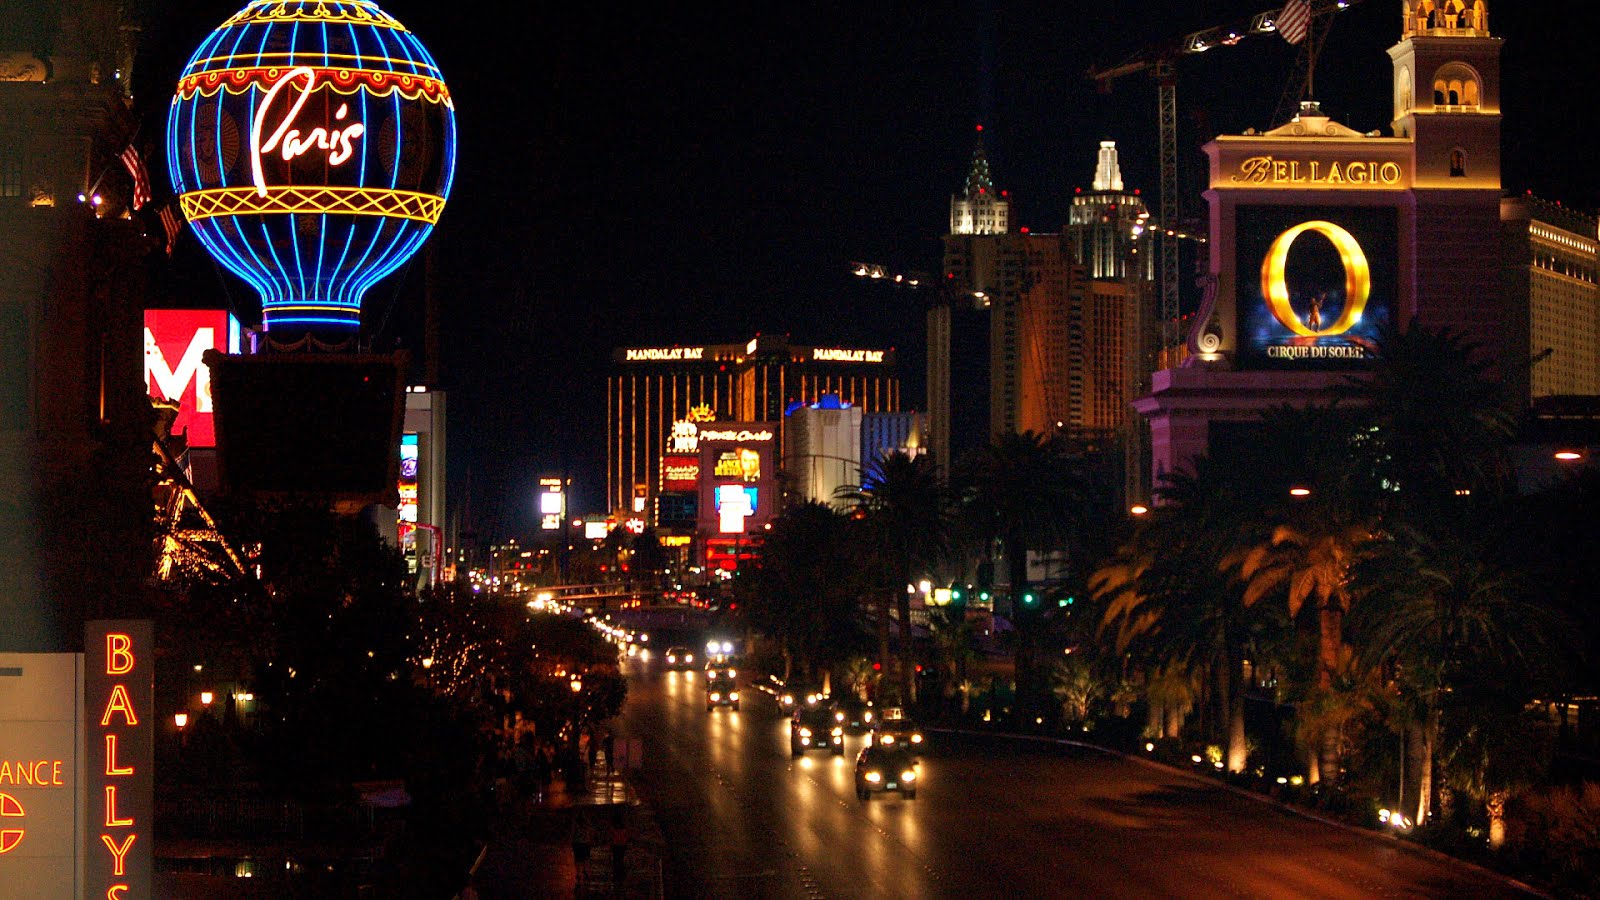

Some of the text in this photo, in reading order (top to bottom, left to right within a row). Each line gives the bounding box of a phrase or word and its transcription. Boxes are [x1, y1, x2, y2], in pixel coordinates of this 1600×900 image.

[251, 66, 364, 198] Paris
[1232, 156, 1403, 185] BELLAGIO
[1261, 220, 1371, 336] O
[626, 348, 704, 361] MANDALAY BAY
[813, 349, 884, 363] MANDALAY BAY
[1267, 346, 1309, 360] CIRQUE
[1310, 346, 1327, 358] DU
[0, 760, 63, 786] ANCE
